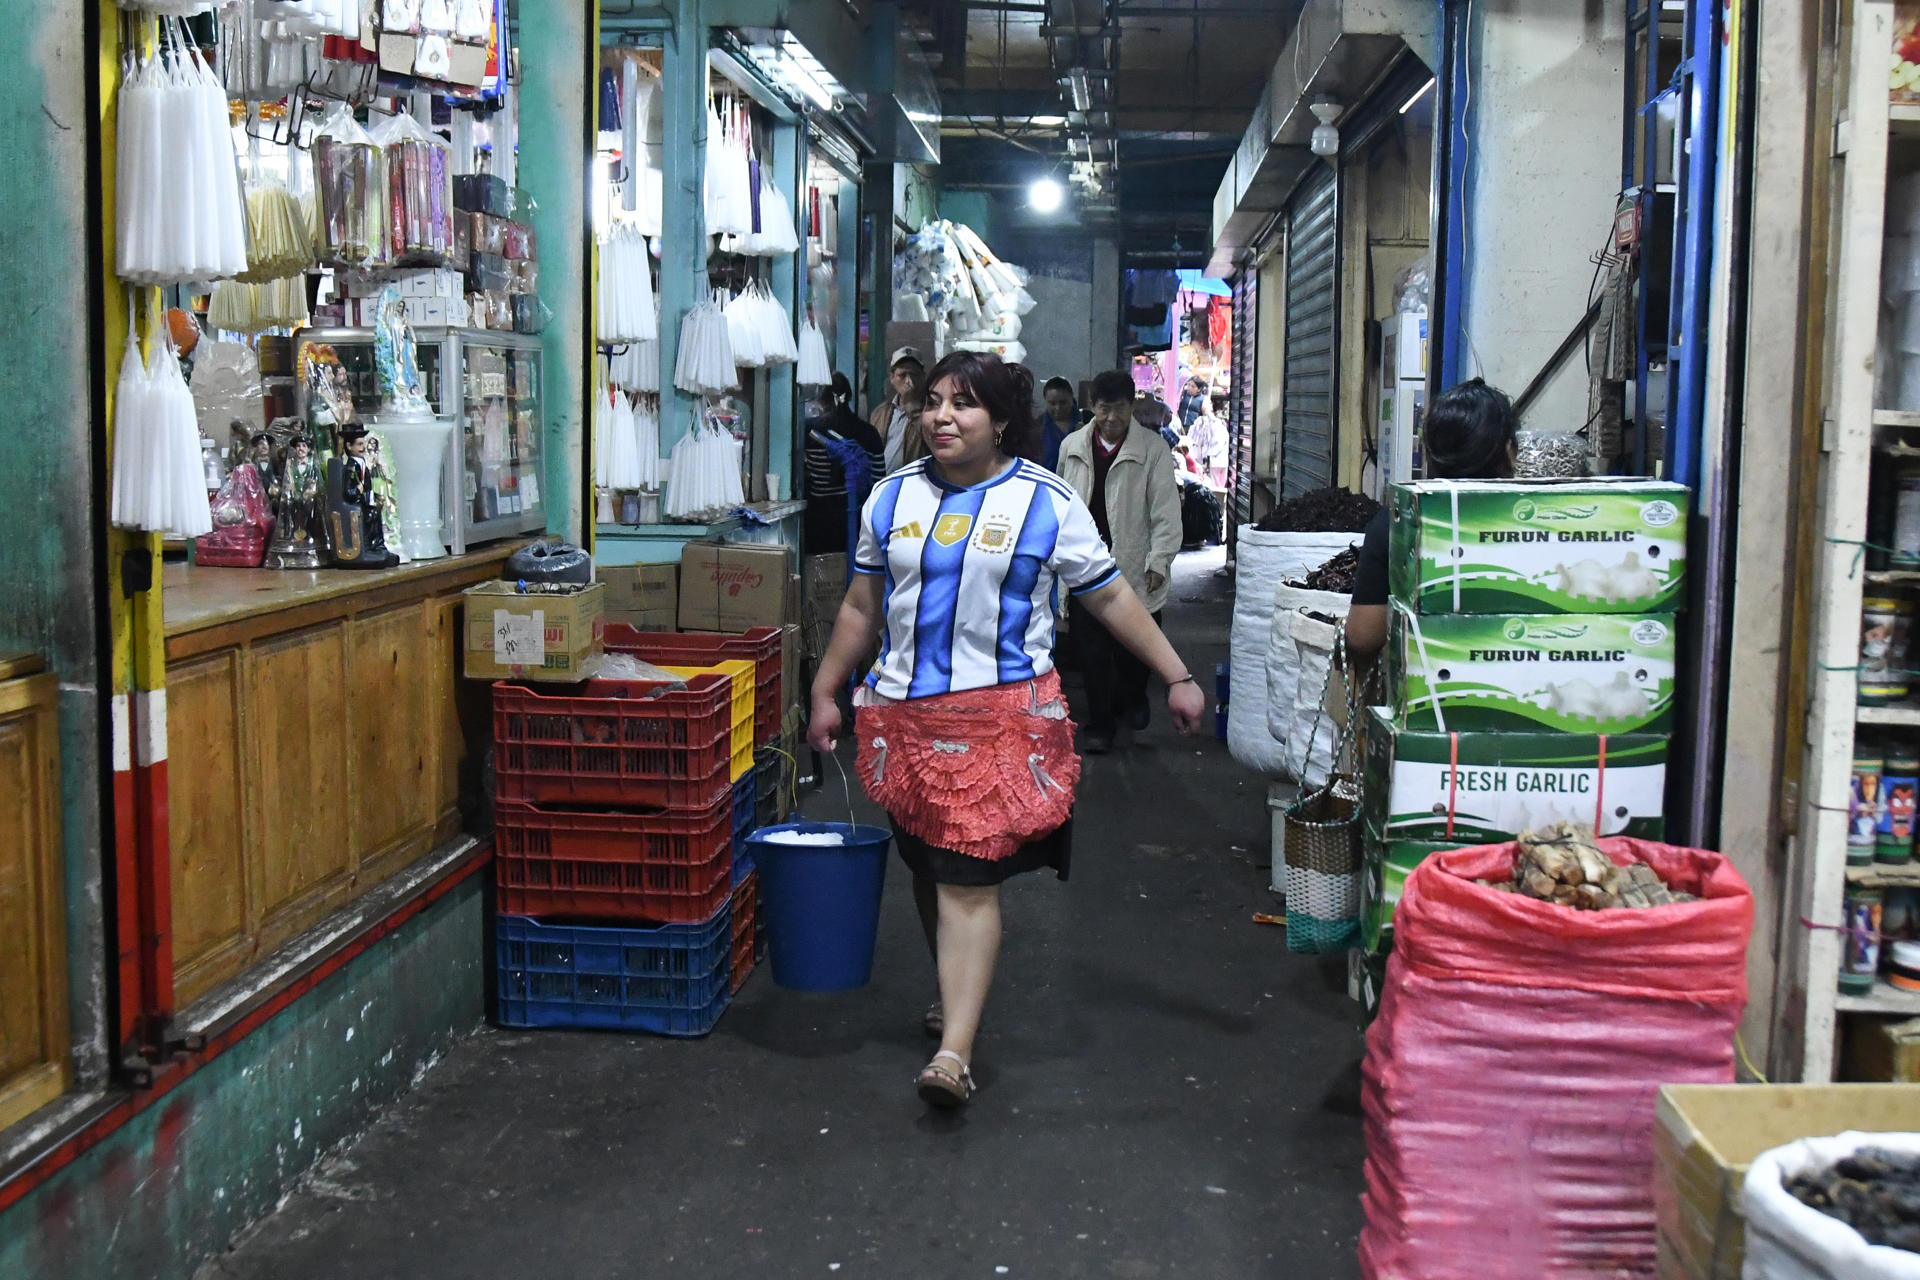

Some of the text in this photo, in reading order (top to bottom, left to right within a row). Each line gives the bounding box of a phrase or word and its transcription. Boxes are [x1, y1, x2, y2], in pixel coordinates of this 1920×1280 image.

[1479, 530, 1635, 543] FURUN GARLIC
[1469, 650, 1626, 662] FURUN GARLIC
[1440, 770, 1590, 793] FRESH GARLIC
